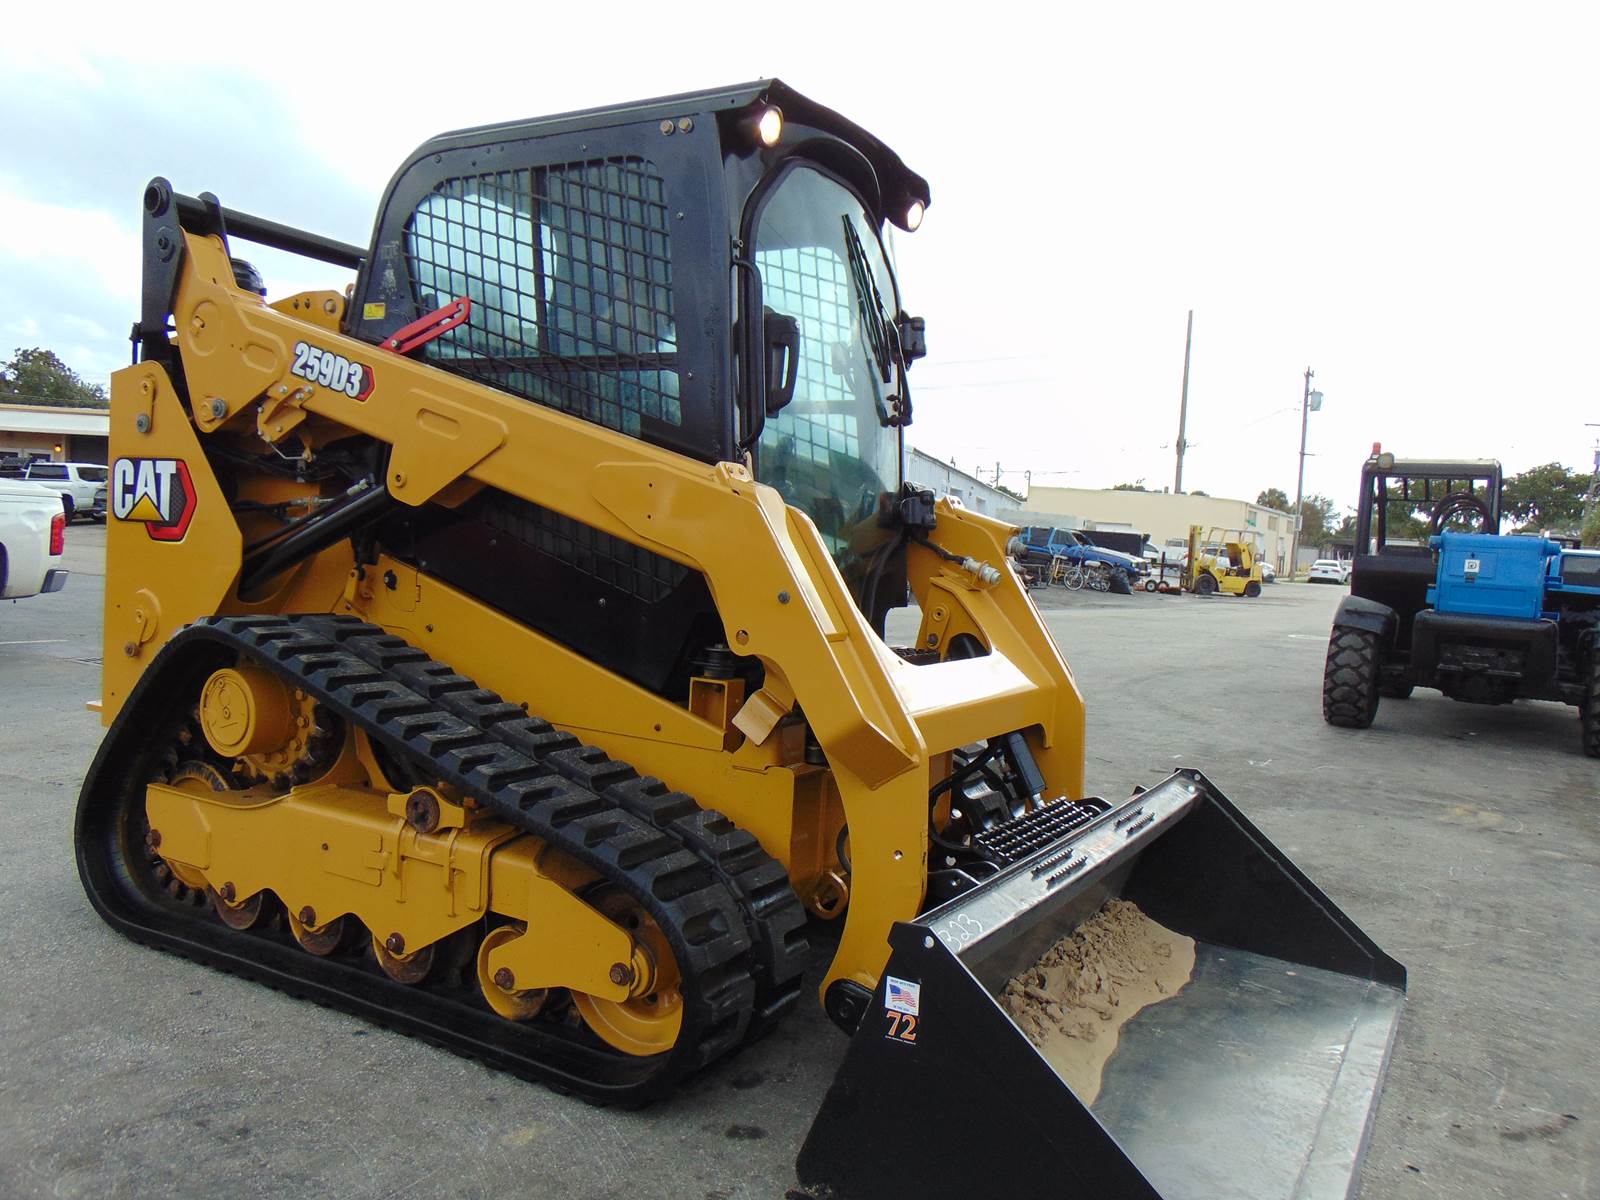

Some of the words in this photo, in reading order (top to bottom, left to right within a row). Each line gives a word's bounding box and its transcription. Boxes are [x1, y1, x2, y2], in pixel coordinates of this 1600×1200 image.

[291, 341, 363, 398] 259D3
[113, 458, 177, 521] CAT
[937, 913, 984, 952] 323
[885, 1010, 917, 1041] 72
